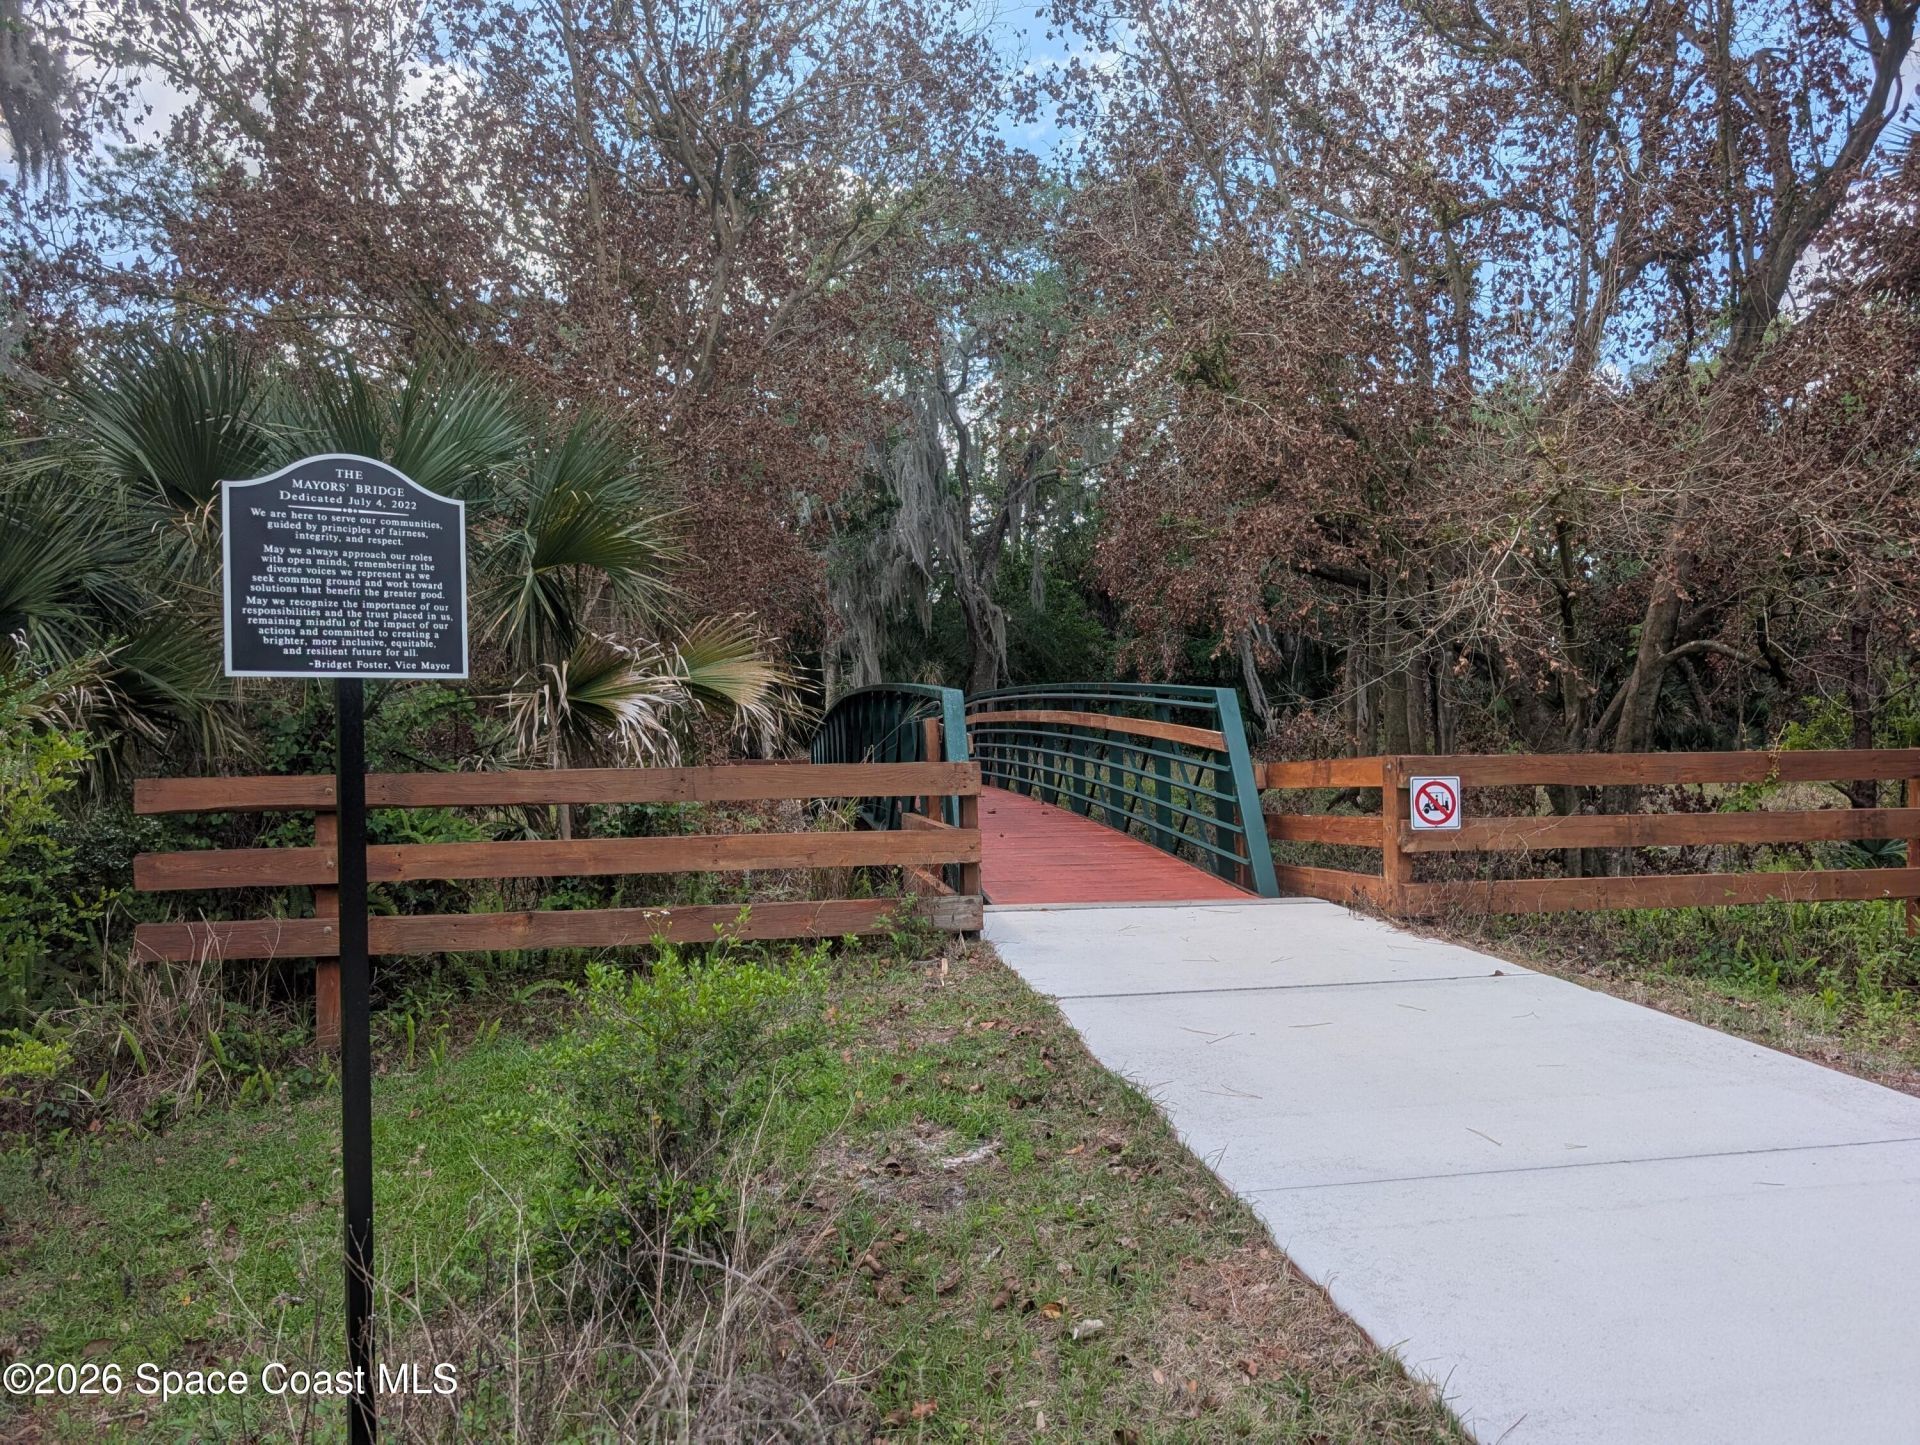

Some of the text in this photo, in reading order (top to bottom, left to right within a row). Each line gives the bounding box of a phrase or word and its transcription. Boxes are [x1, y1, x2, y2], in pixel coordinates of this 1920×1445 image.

[336, 468, 363, 480] THE
[292, 479, 404, 496] MAYORS' BRIDGE
[279, 490, 416, 510] Dedicated July 4, 2022
[251, 508, 443, 530] We are here to serve our communities,
[267, 520, 429, 539] guided by principles of fairness,
[295, 531, 404, 547] integrity, and respect.
[263, 544, 285, 556] May
[306, 546, 338, 557] always
[342, 549, 387, 560] approach
[410, 553, 432, 562] roles
[261, 554, 435, 571] with open minds, remembering the
[267, 564, 302, 573] diverse
[306, 566, 336, 575] voices
[357, 569, 401, 579] represent
[252, 573, 442, 590] seek common ground and work toward
[250, 584, 445, 599] solutions that benefit the greater good.
[246, 596, 268, 606] May
[290, 598, 338, 608] recognize
[343, 599, 358, 608] the
[362, 600, 416, 610] importance
[420, 602, 430, 610] of
[242, 607, 454, 621] responsibilities and the trust placed in us,
[248, 617, 448, 630] remaining mindful of the impact of our
[258, 627, 295, 635] actions
[300, 628, 318, 636] and
[322, 628, 374, 637] committed
[392, 630, 430, 639] creating
[263, 636, 436, 649] brighter, more inclusive, equitable,
[283, 646, 418, 657] and resilient future for all.
[356, 660, 391, 670] Foster,
[395, 661, 417, 669] Vice
[421, 662, 450, 671] Mayor
